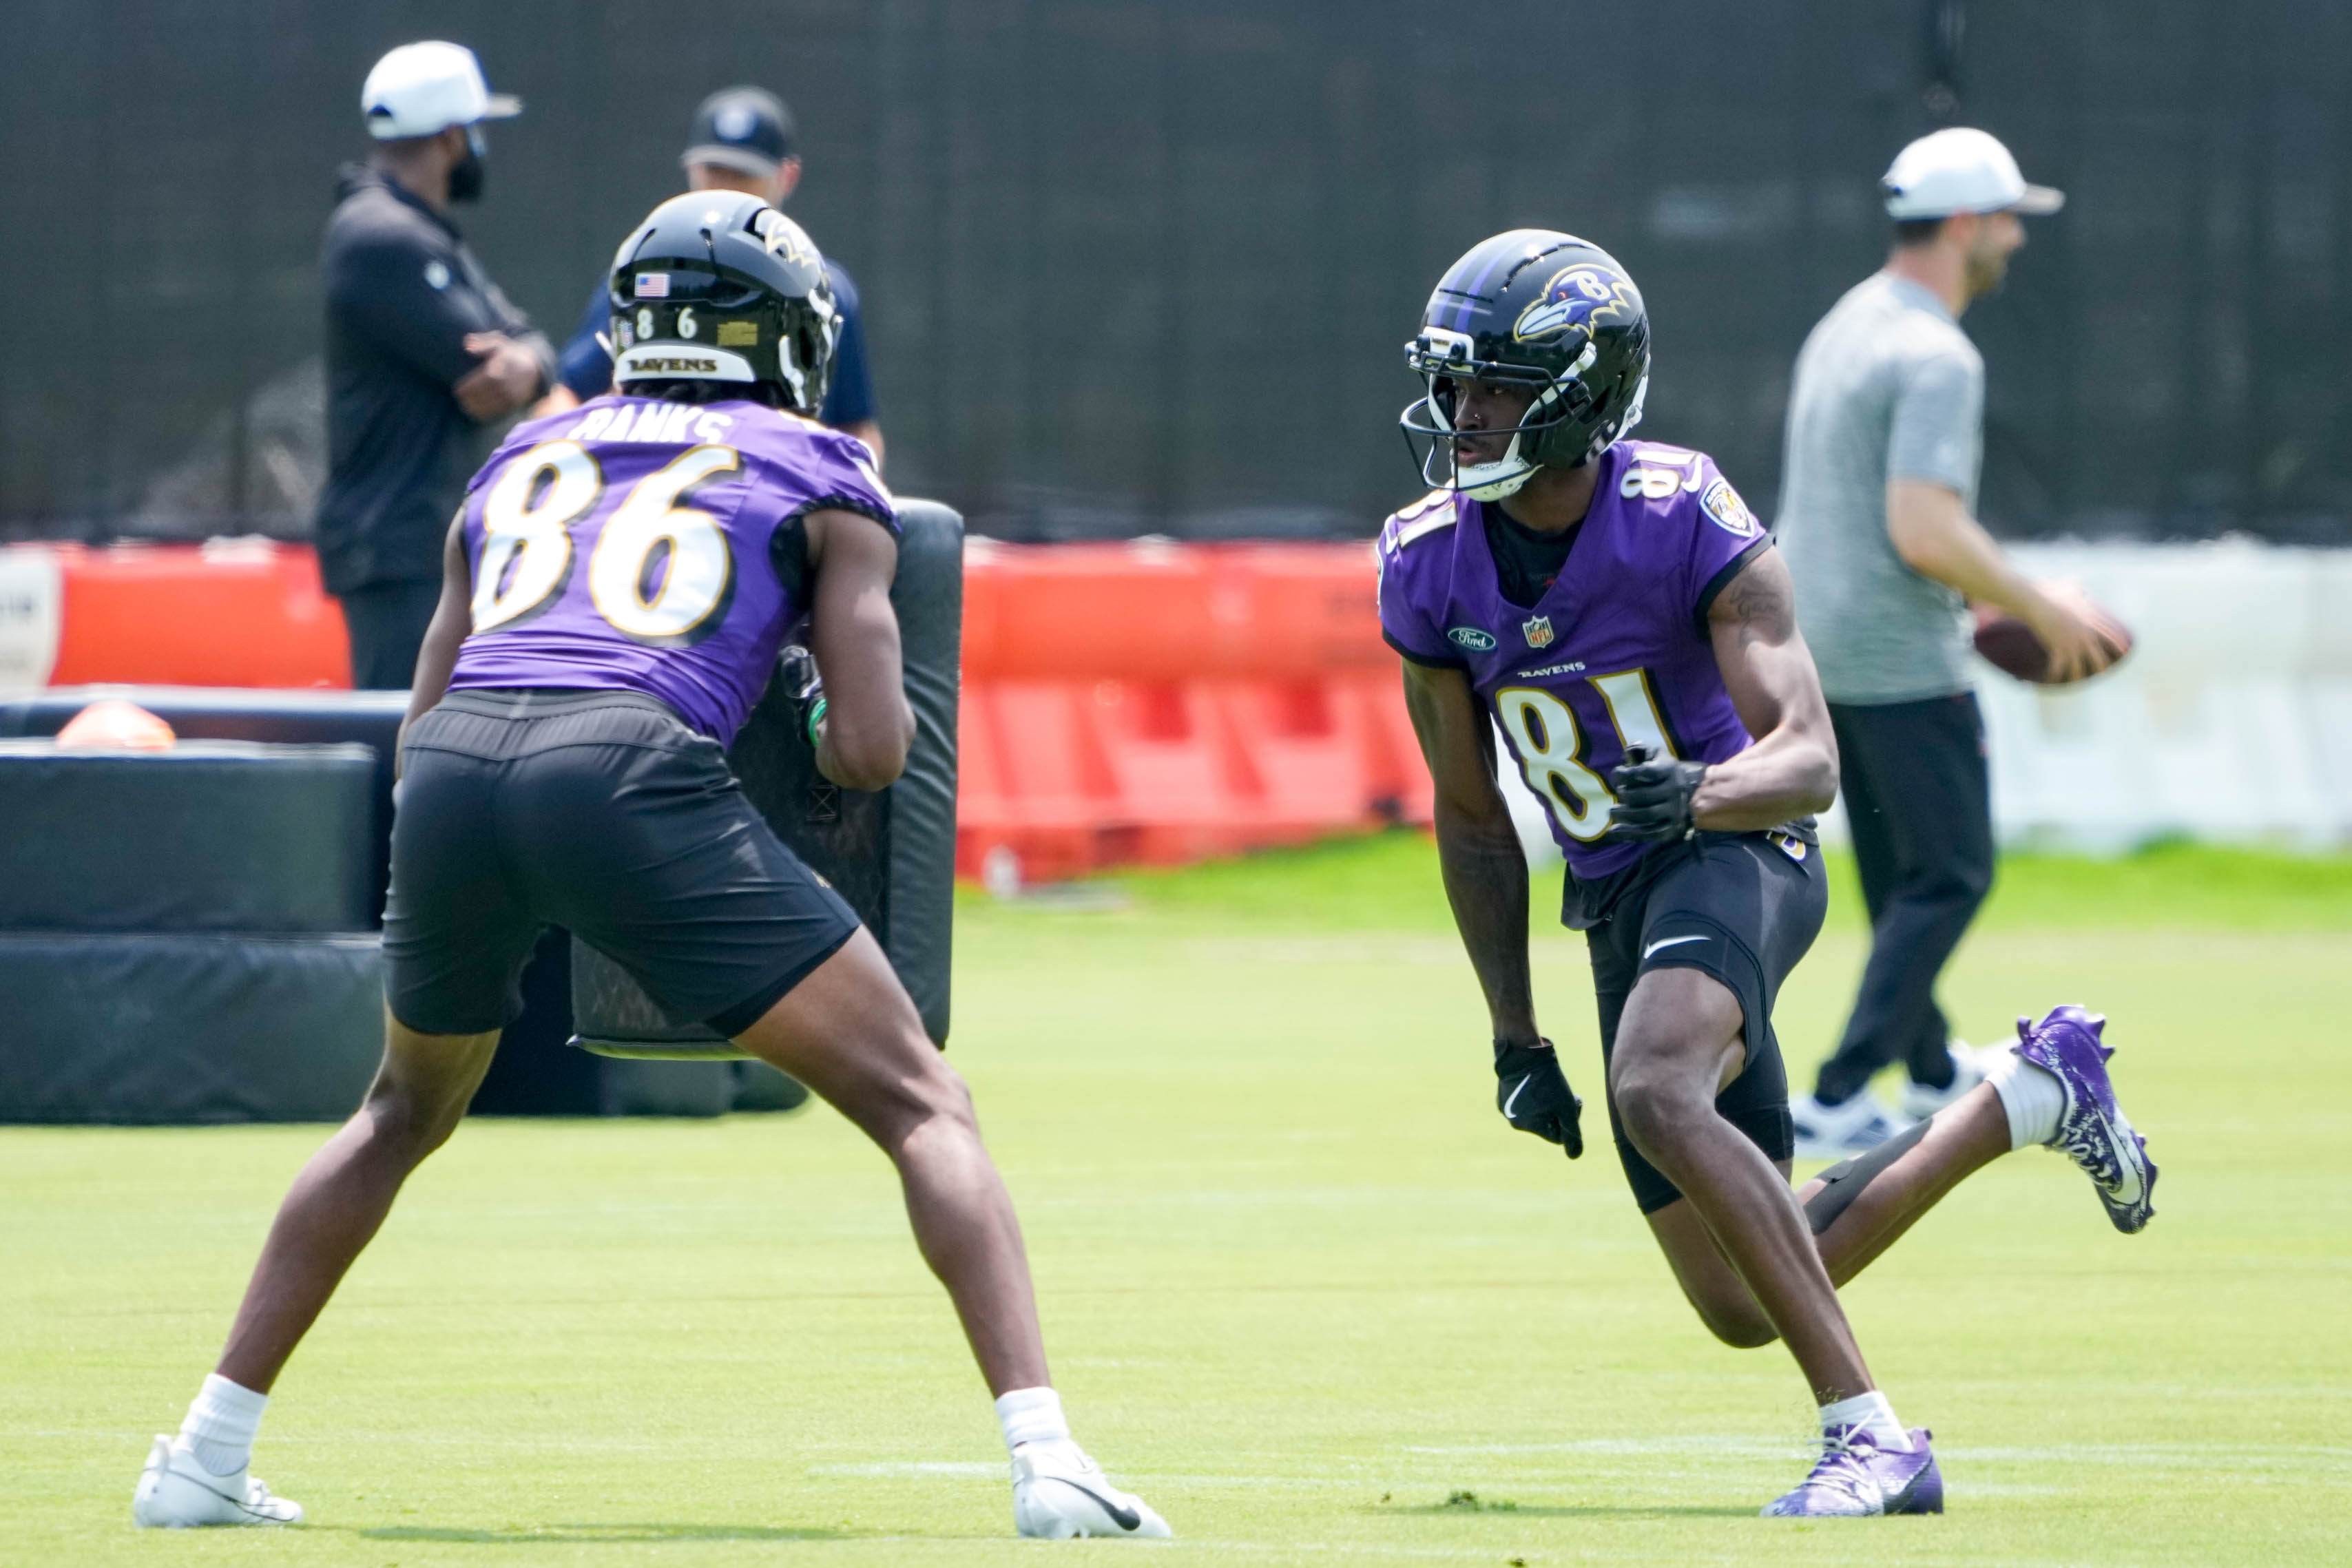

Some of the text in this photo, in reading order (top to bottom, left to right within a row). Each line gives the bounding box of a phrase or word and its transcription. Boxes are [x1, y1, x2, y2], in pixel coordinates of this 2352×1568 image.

[1576, 271, 1610, 300] B
[629, 357, 718, 373] RAVENS
[470, 439, 740, 638] 86
[1458, 630, 1486, 648] Ford
[1530, 630, 1550, 642] NFL
[1517, 662, 1586, 678] RAVENS
[1495, 667, 1678, 843] 81
